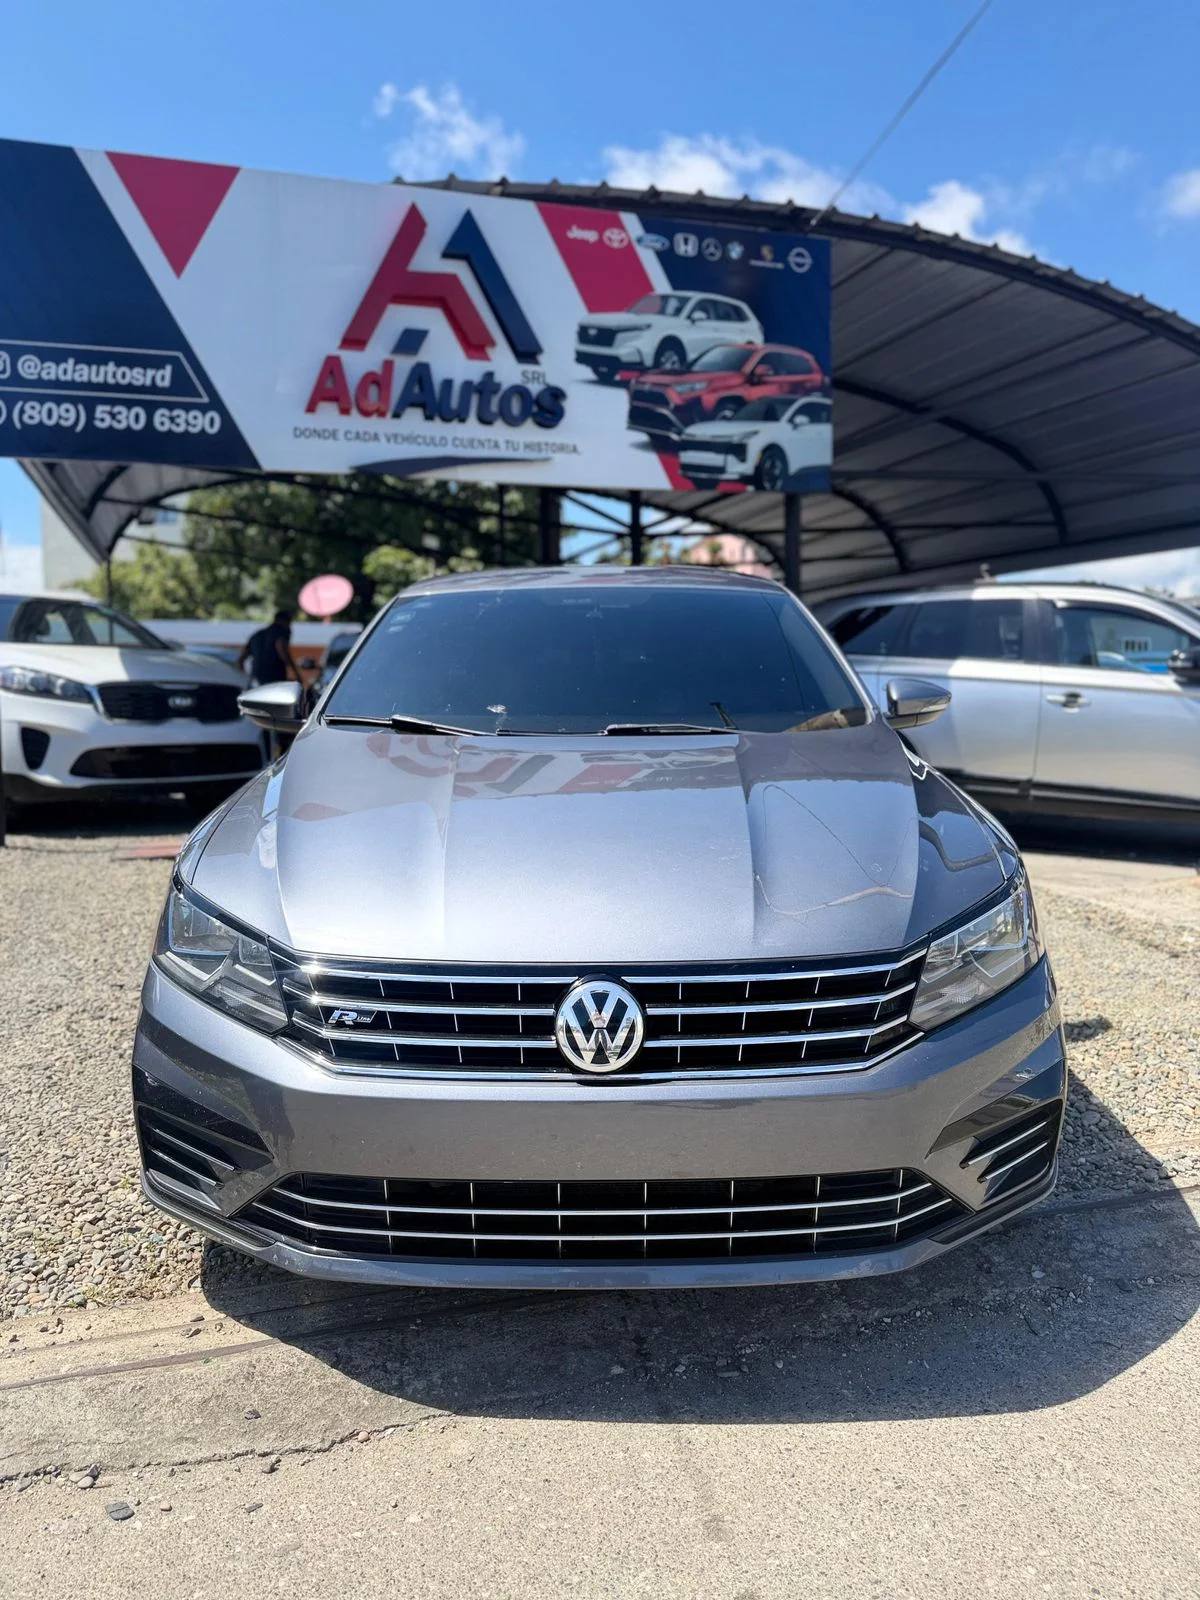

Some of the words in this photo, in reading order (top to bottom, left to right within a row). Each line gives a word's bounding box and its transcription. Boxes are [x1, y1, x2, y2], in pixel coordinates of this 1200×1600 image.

[17, 354, 172, 388] @adautosrd
[521, 369, 548, 386] SRL
[304, 354, 567, 429] AdAutos
[12, 400, 87, 433] (809)
[94, 404, 147, 431] 530
[153, 408, 222, 434] 6390
[293, 426, 341, 441] DONDE
[344, 430, 381, 443] CADA
[384, 430, 448, 448] VEHÍCULO
[452, 436, 500, 450] CUENTA
[505, 439, 520, 451] TU
[557, 980, 644, 1073] VW
